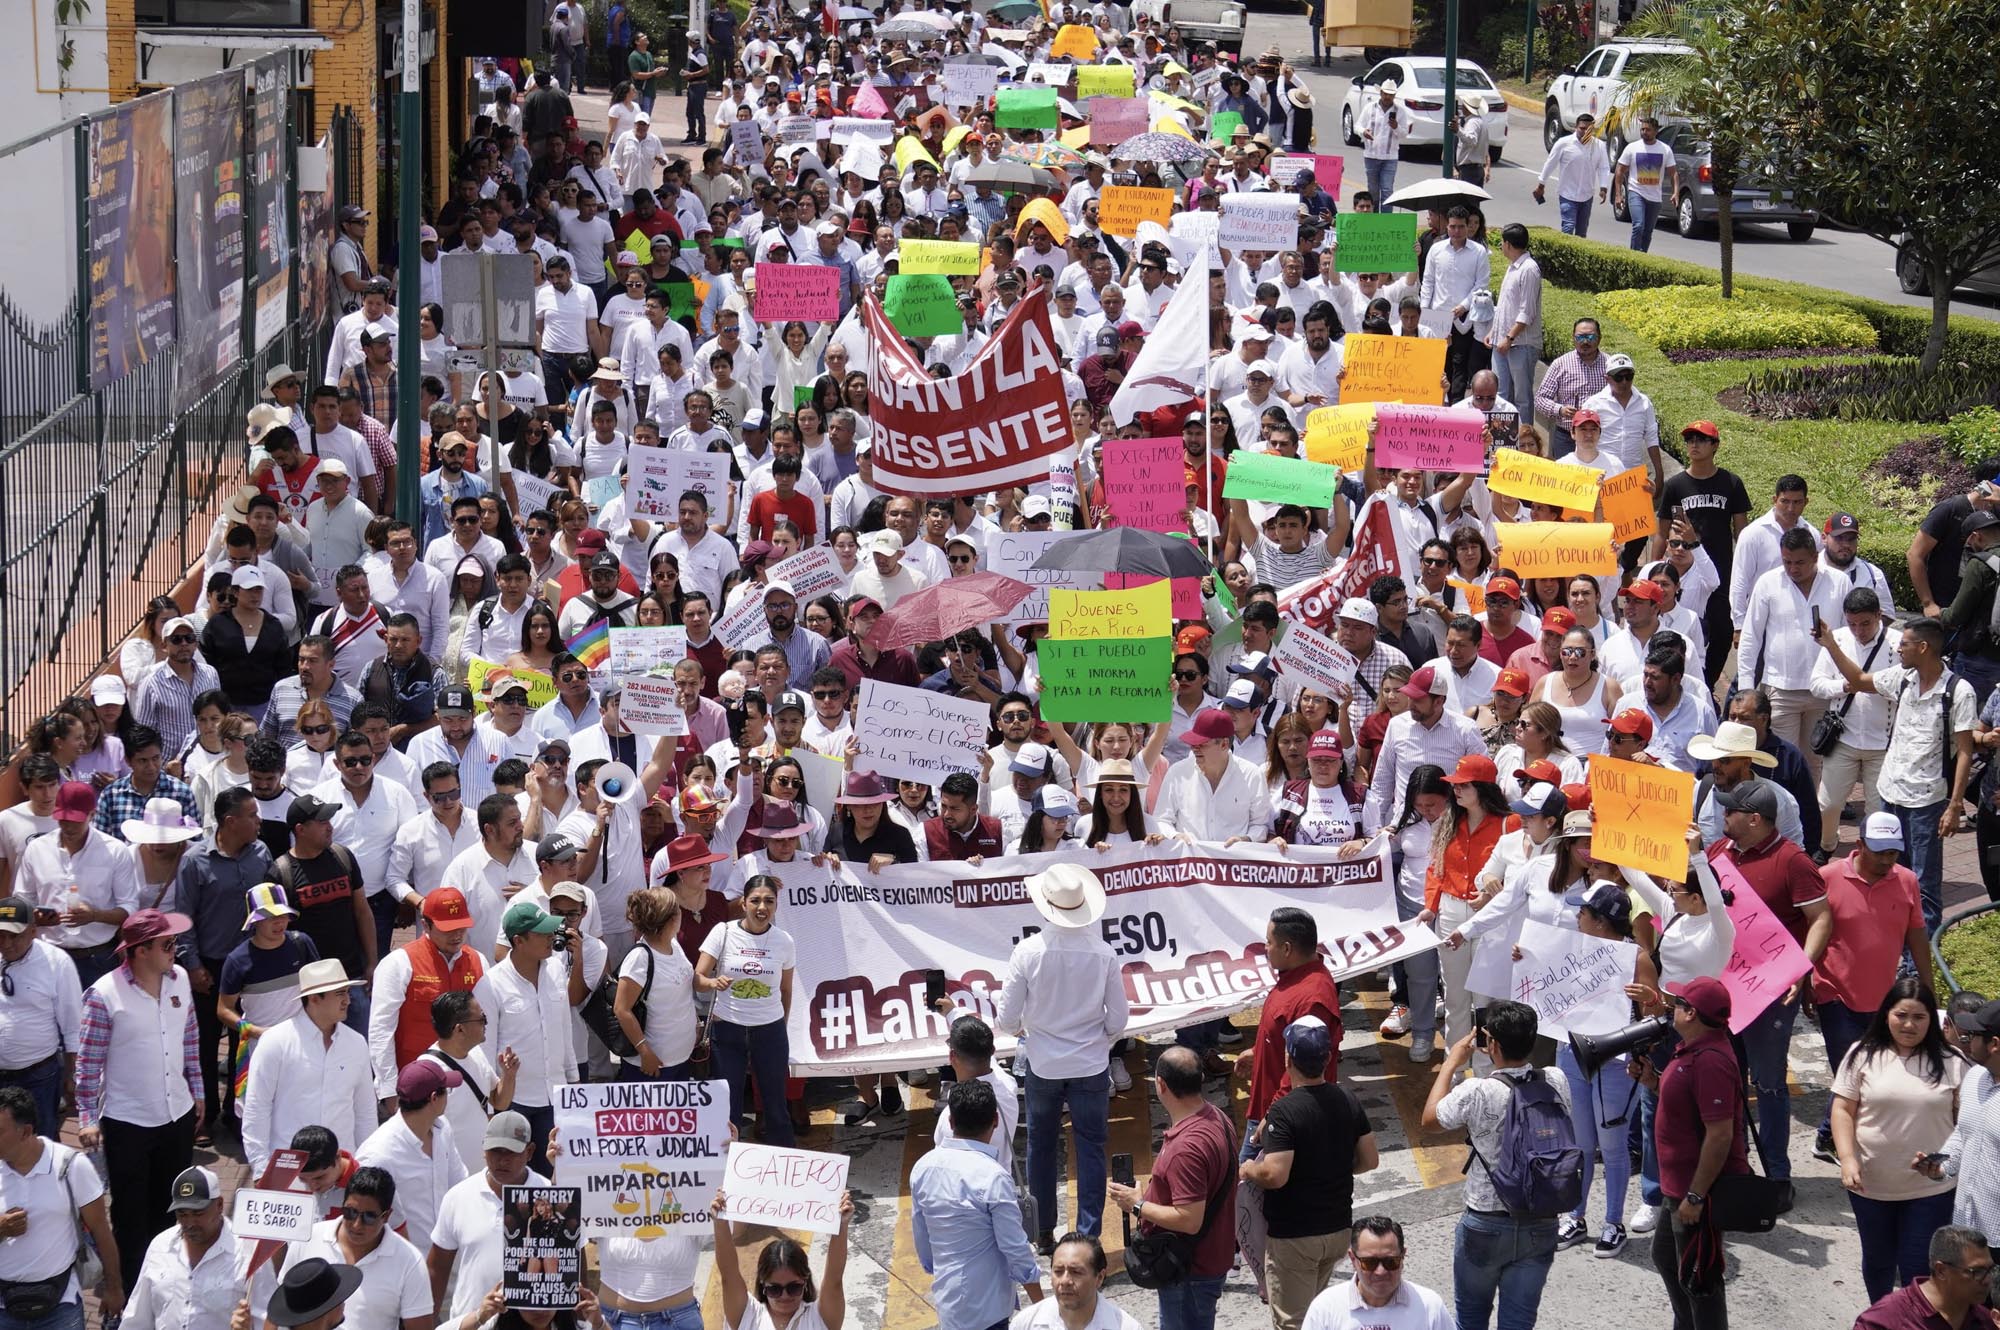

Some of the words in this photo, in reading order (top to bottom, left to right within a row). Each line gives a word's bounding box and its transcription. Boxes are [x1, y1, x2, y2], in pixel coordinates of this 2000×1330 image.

[1107, 189, 1119, 199] SOY
[1107, 203, 1111, 211] Y
[1118, 204, 1142, 214] APOYO
[1237, 206, 1264, 220] PODER
[1340, 231, 1408, 241] ESTUDIANTES
[1349, 340, 1385, 357] BASTA
[1394, 341, 1413, 359] DE
[1347, 361, 1414, 380] PRIVILEGIOS
[1384, 427, 1403, 438] LOS
[1410, 427, 1459, 441] MINISTROS
[1342, 436, 1357, 449] SIN
[1388, 440, 1408, 451] NOS
[1416, 442, 1440, 454] IBAN
[1448, 444, 1454, 453] A
[1110, 447, 1182, 465] EXIGIMOS
[1415, 457, 1453, 468] CUIDAR
[1133, 467, 1151, 481] UN
[1502, 468, 1523, 483] CON
[1106, 484, 1134, 495] PODER
[1140, 481, 1181, 494] JUDICIAL
[1130, 500, 1153, 512] SIN
[1001, 539, 1034, 561] Con
[1512, 547, 1550, 567] VOTO
[1556, 547, 1607, 565] POPULAR
[1018, 569, 1073, 583] TODO
[733, 591, 763, 620] MILLONES
[1066, 594, 1138, 617] JOVENES
[1060, 619, 1100, 636] POZA
[1109, 618, 1145, 636] RICA
[1048, 645, 1062, 659] SI
[1073, 646, 1088, 657] EL
[1099, 644, 1146, 657] PUEBLO
[1294, 628, 1310, 641] 282
[1311, 638, 1351, 666] MILLONES
[1065, 668, 1077, 678] SE
[1089, 668, 1136, 679] INFORMA
[627, 682, 639, 690] 282
[640, 684, 675, 695] MILLONES
[1053, 686, 1082, 698] PASA
[1088, 686, 1101, 696] LA
[1110, 686, 1162, 698] REFORMA
[866, 682, 908, 716] Los
[912, 695, 980, 727] Jóvenes
[864, 716, 922, 740] Somos
[928, 728, 944, 744] El
[856, 742, 874, 757] De
[880, 747, 896, 761] La
[1595, 766, 1627, 797] PODER
[1635, 775, 1681, 807] JUDICIAL
[1309, 819, 1350, 827] MARCHA
[1602, 829, 1627, 851] VOTO
[1633, 834, 1674, 863] POPULAR
[789, 887, 817, 906] LOS
[821, 880, 880, 903] JÓVENES
[883, 886, 953, 906] EXIGIMOS
[957, 884, 978, 905] UN
[1104, 862, 1216, 892] DEMOCRATIZADO
[1218, 863, 1228, 882] Y
[1231, 865, 1299, 884] CERCANO
[1301, 866, 1320, 884] AL
[1323, 859, 1378, 883] PUEBLO
[1739, 912, 1758, 931] A
[1101, 911, 1176, 958] ESO,
[1760, 932, 1786, 962] LA
[464, 975, 475, 985] PT
[561, 1087, 588, 1109] LAS
[600, 1081, 713, 1109] JUVENTUDES
[599, 1110, 696, 1134] EXIGIMOS
[569, 1138, 592, 1158] UN
[598, 1136, 649, 1158] PODER
[656, 1135, 718, 1158] JUDICIAL
[587, 1171, 706, 1193] IMPARCIAL
[511, 1189, 529, 1203] I'M
[532, 1190, 574, 1203] SORRY
[246, 1200, 258, 1212] EL
[263, 1201, 302, 1217] PUEBLO
[248, 1214, 259, 1224] ES
[582, 1217, 591, 1227] Y
[596, 1217, 618, 1228] SIN
[522, 1238, 537, 1247] THE
[539, 1238, 555, 1247] OLD
[505, 1247, 534, 1258] PODER
[537, 1247, 577, 1258] JUDICIAL
[518, 1272, 543, 1282] RIGHT
[544, 1272, 563, 1282] NOW
[504, 1288, 530, 1300] WHY?
[531, 1294, 549, 1304] IT'S
[551, 1294, 577, 1305] DEAD
